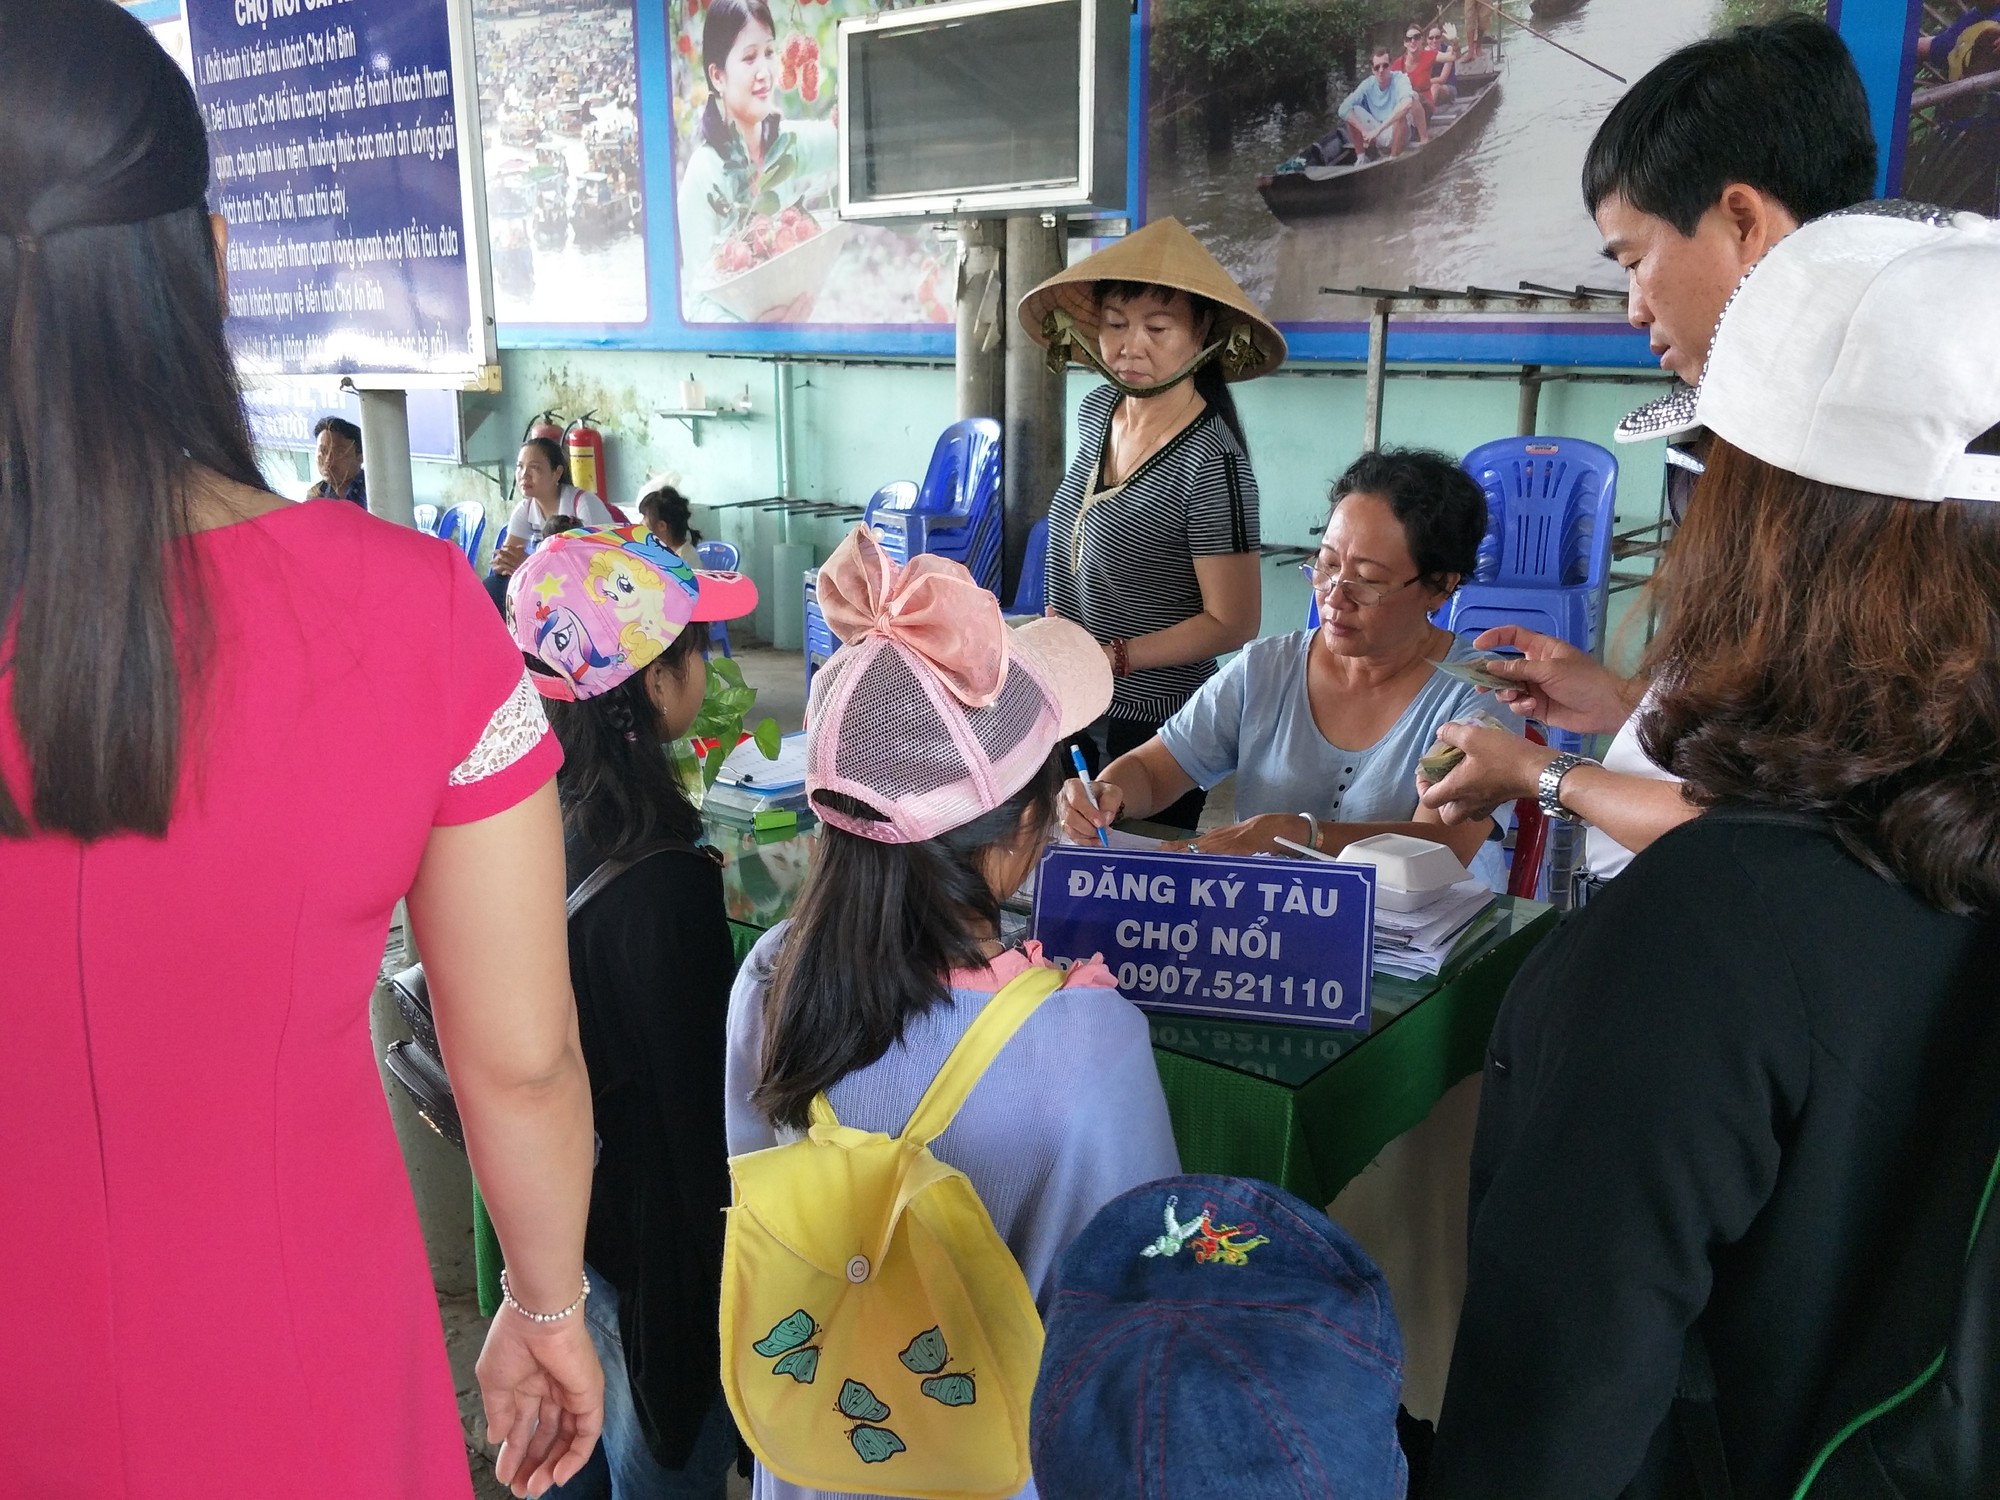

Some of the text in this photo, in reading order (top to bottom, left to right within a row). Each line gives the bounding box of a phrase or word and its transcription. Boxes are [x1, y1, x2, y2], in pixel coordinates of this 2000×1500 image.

[221, 49, 242, 81] hành
[250, 39, 267, 76] bến
[267, 40, 281, 73] tàu
[280, 35, 307, 70] khách
[306, 32, 324, 71] Chợ
[337, 25, 357, 58] Bình
[211, 97, 228, 131] Đến
[226, 99, 242, 129] khu
[242, 99, 257, 133] vực
[258, 93, 275, 130] Chợ
[275, 81, 290, 121] Nổi
[290, 86, 305, 119] tàu
[306, 85, 326, 122] chạy
[328, 79, 353, 118] chậm
[354, 66, 366, 109] để
[367, 72, 391, 106] hành
[391, 66, 422, 103] khách
[423, 65, 449, 98] tham
[237, 146, 256, 182] chụp
[256, 142, 273, 173] hình
[273, 141, 286, 172] lưu
[286, 138, 308, 176] niệm,
[308, 128, 337, 172] thưởng
[336, 129, 356, 162] thức
[357, 126, 374, 160] các
[375, 123, 396, 158] món
[397, 122, 410, 156] ăn
[410, 115, 435, 160] uống
[436, 110, 455, 160] giải
[236, 193, 253, 223] bán
[252, 192, 264, 229] tại
[264, 191, 280, 228] Chợ
[297, 193, 315, 217] mua
[314, 183, 329, 215] trái
[330, 183, 349, 220] cây.
[240, 240, 258, 270] thúc
[259, 234, 288, 275] chuyến
[287, 237, 309, 267] tham
[310, 241, 332, 272] quan
[331, 231, 355, 270] vòng
[355, 229, 384, 269] quanh
[384, 228, 402, 268] chợ
[403, 217, 420, 258] Nổi
[420, 224, 438, 257] tàu
[439, 224, 458, 257] đưa
[248, 286, 274, 316] khách
[274, 291, 293, 321] quay
[293, 278, 304, 314] về
[304, 279, 321, 314] Bến
[320, 281, 335, 313] tàu
[335, 281, 353, 319] Chợ
[354, 282, 367, 311] An
[365, 280, 385, 311] Bình
[1068, 865, 1339, 917] ĐĂNG KÝ TÀU
[1115, 916, 1281, 960] CHỢ NỔI
[1118, 962, 1343, 1009] 0907.521110
